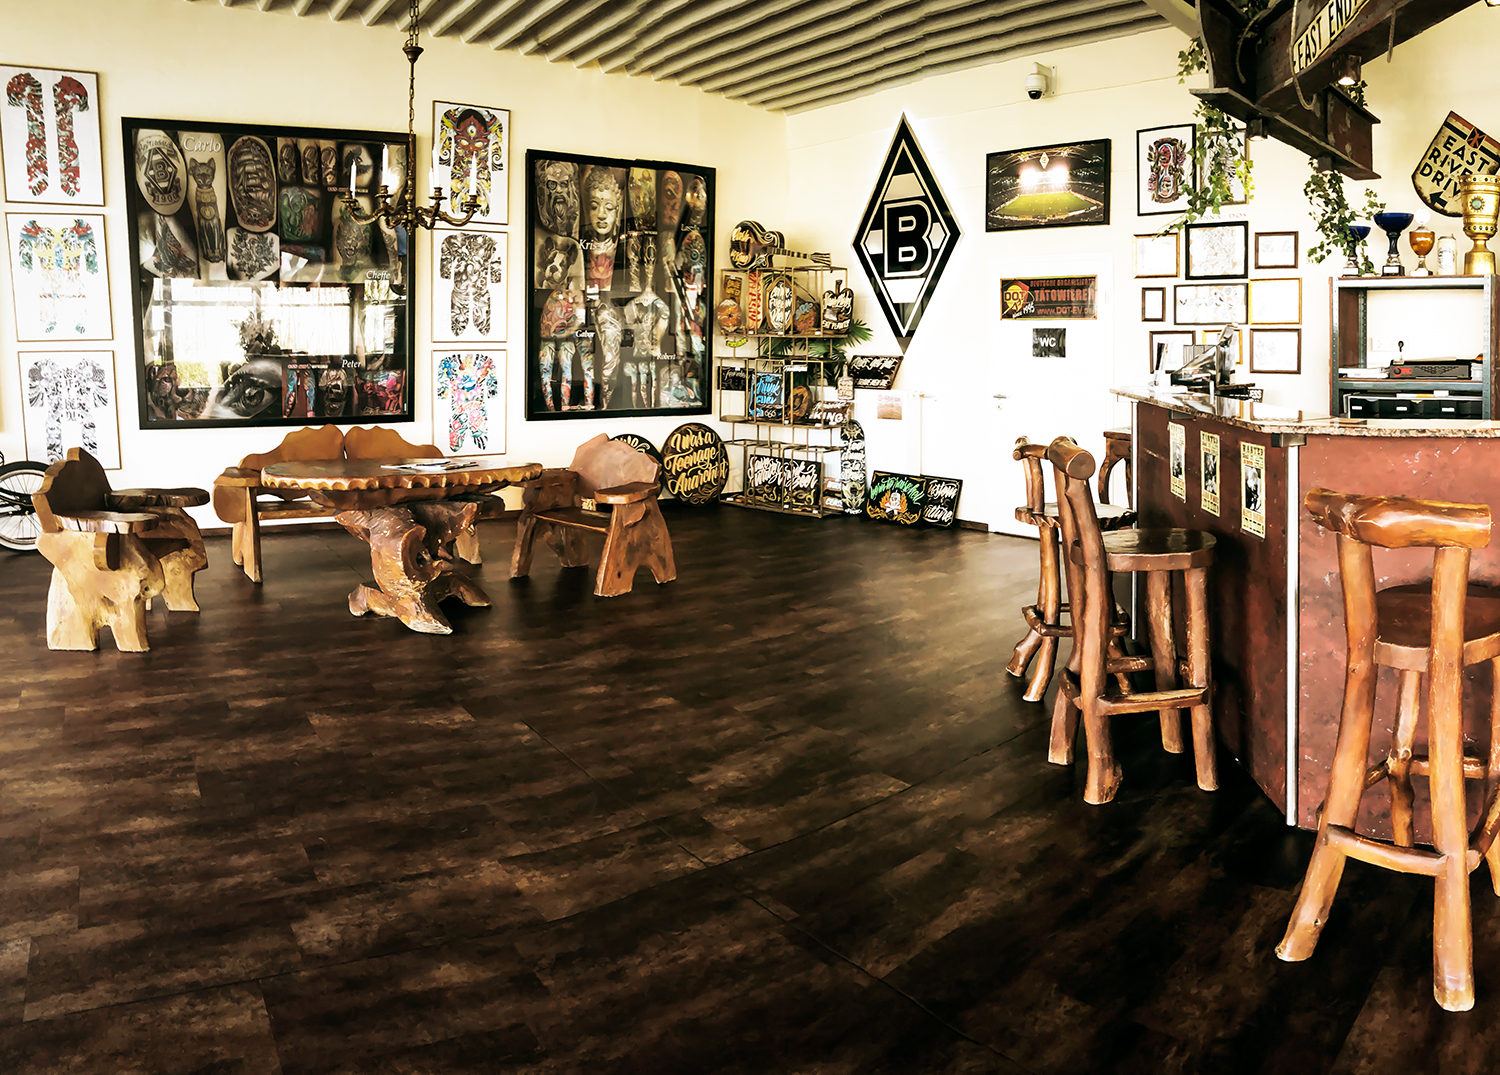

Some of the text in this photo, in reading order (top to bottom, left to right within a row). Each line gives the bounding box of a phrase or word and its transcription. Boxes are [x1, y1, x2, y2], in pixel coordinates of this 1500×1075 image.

[1297, 15, 1322, 70] EAST
[183, 136, 221, 152] Carlo
[1442, 135, 1490, 172] EAST
[1419, 162, 1461, 197] DRIV
[1004, 291, 1025, 301] DOT
[1034, 288, 1095, 302] TÄTOWIERER
[1023, 302, 1035, 315] 1995
[1040, 337, 1056, 347] WC
[341, 359, 361, 369] Peter
[764, 408, 777, 418] 666
[664, 446, 720, 475] Teenage
